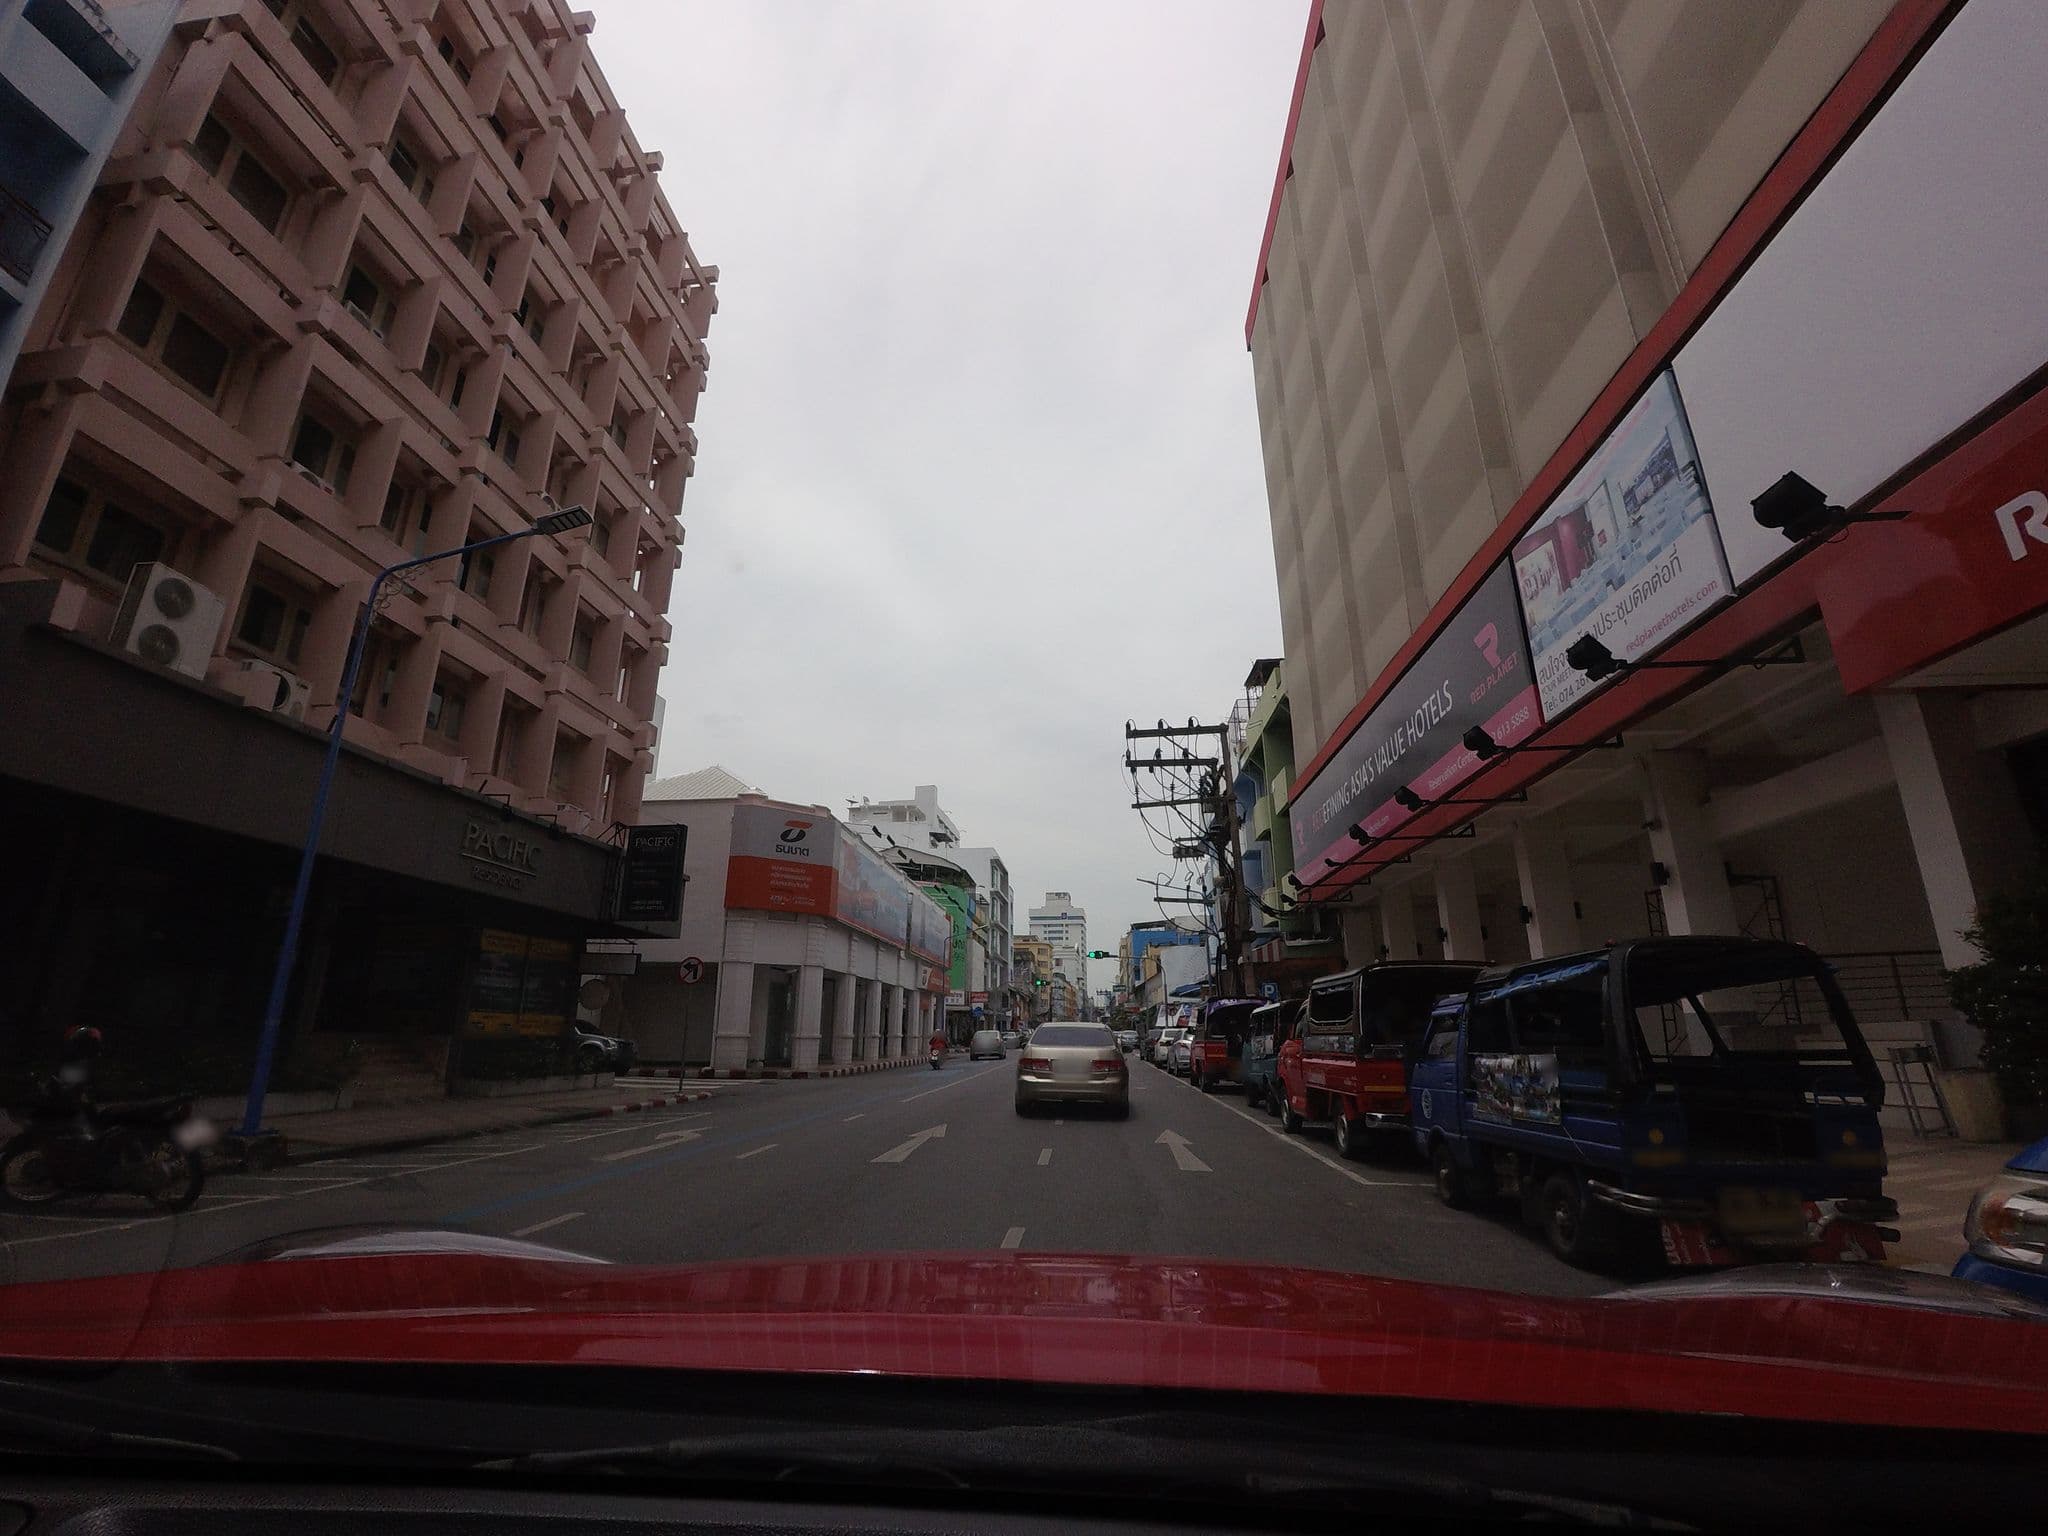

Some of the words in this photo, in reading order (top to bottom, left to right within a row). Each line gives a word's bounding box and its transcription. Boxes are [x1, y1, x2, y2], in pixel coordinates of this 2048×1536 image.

[1625, 578, 1719, 655] redplanethotels.com
[1470, 683, 1487, 705] RED
[1486, 651, 1519, 690] PLANET
[1544, 695, 1559, 713] Tel:
[1558, 684, 1575, 703] 074
[1350, 758, 1376, 800] ASIA'S
[1374, 727, 1408, 776] VALUE
[1406, 679, 1455, 747] HOTELS
[465, 822, 540, 868] PACIFIC
[634, 835, 675, 849] PACIFIC
[1263, 983, 1276, 998] P
